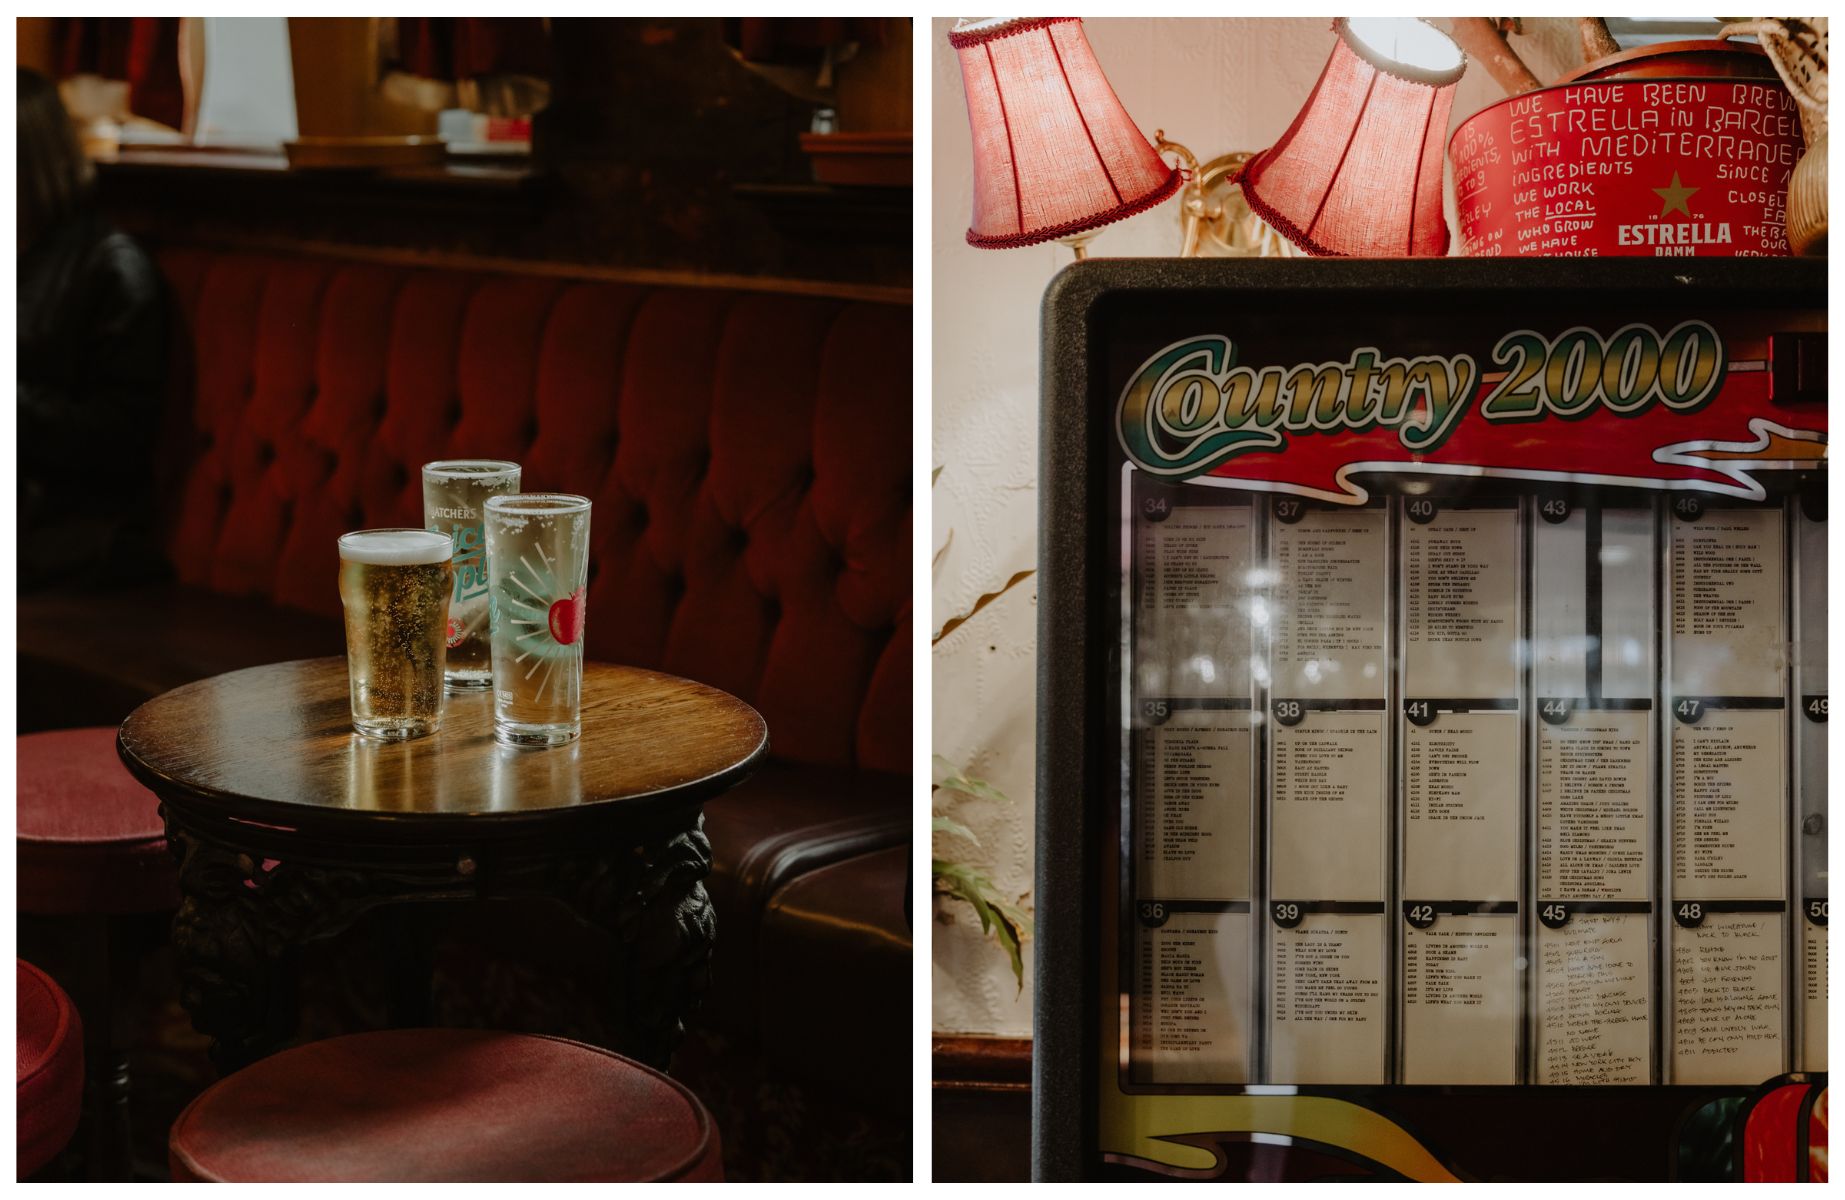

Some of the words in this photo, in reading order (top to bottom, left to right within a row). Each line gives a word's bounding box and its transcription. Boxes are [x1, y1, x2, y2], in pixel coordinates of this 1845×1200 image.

[1509, 96, 1543, 117] WE
[1566, 86, 1624, 105] HAVE
[1643, 84, 1706, 106] BEEN
[1510, 108, 1659, 144] ESTRELLA
[1513, 189, 1537, 205] WE
[1543, 182, 1595, 199] WORK
[1515, 206, 1540, 222] THE
[1545, 200, 1595, 217] LOCAL
[1518, 225, 1551, 242] WHO
[1554, 220, 1594, 234] GROW
[1618, 223, 1733, 245] ESTRELLA
[1743, 225, 1770, 238] THE
[1519, 241, 1538, 254] WE
[1541, 235, 1578, 250] HAVE
[1655, 246, 1696, 257] DAMM
[1760, 240, 1788, 251] OUR
[1116, 334, 1478, 475] Country
[1485, 320, 1729, 421] 2000
[1145, 498, 1167, 513] 34
[1278, 501, 1300, 517] 37
[1410, 500, 1433, 516] 40
[1543, 500, 1566, 516] 43
[1676, 498, 1698, 513] 46
[1145, 702, 1167, 716] 35
[1277, 702, 1300, 717] 38
[1408, 702, 1428, 717] 41
[1543, 701, 1566, 715] 44
[1678, 700, 1699, 715] 47
[1142, 903, 1164, 918] 36
[1276, 904, 1299, 919] 39
[1409, 906, 1433, 921] 42
[1543, 905, 1565, 920] 45
[1679, 904, 1701, 919] 48
